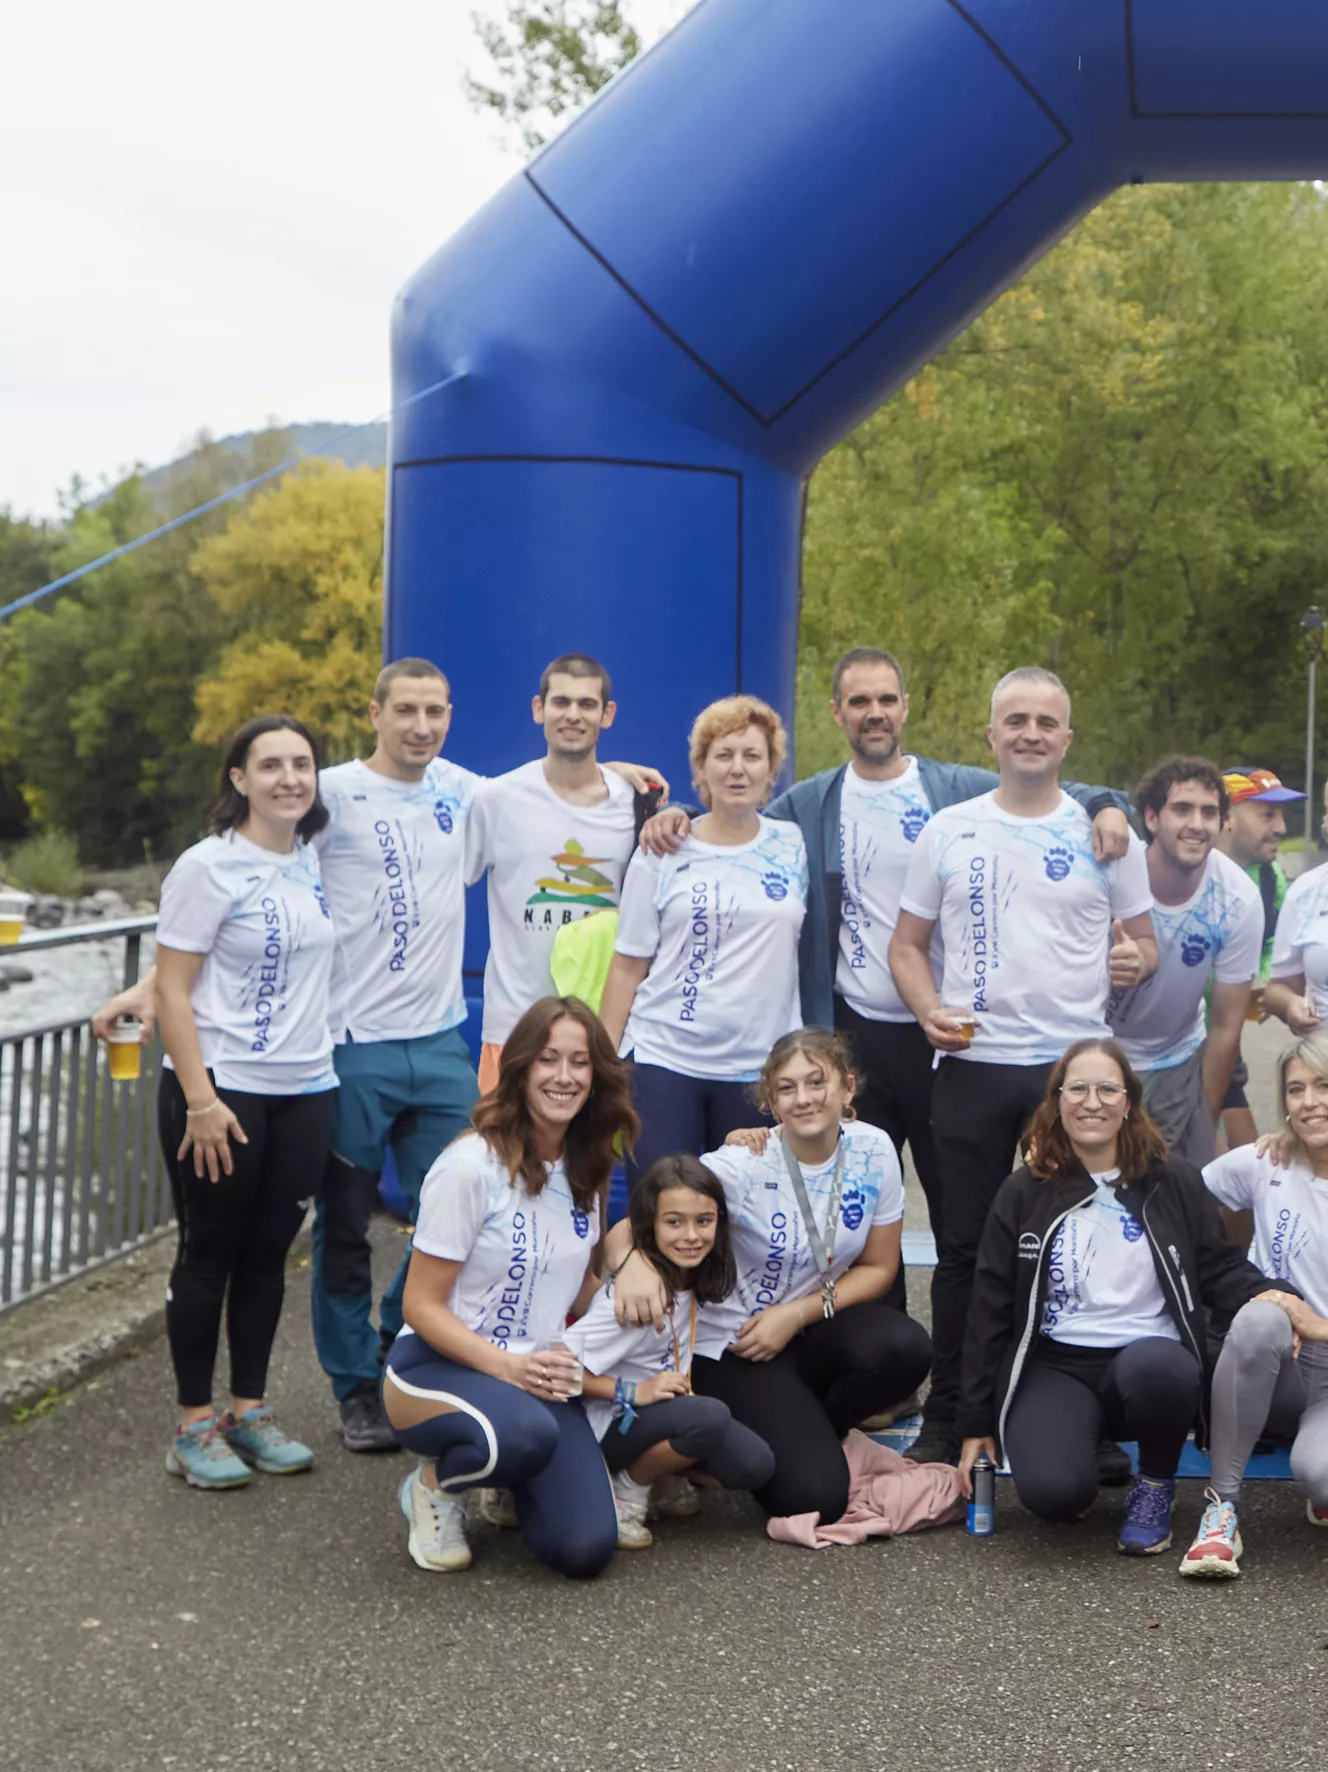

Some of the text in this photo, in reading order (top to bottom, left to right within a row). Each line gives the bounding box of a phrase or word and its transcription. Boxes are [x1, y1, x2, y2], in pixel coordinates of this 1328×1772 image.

[847, 919, 866, 968] PASO
[969, 857, 989, 1012] PASO DELONSO
[251, 999, 272, 1052] PASO
[680, 972, 700, 1022] PASO
[497, 1212, 526, 1321] DELONSO
[756, 1212, 786, 1305] DELONSO
